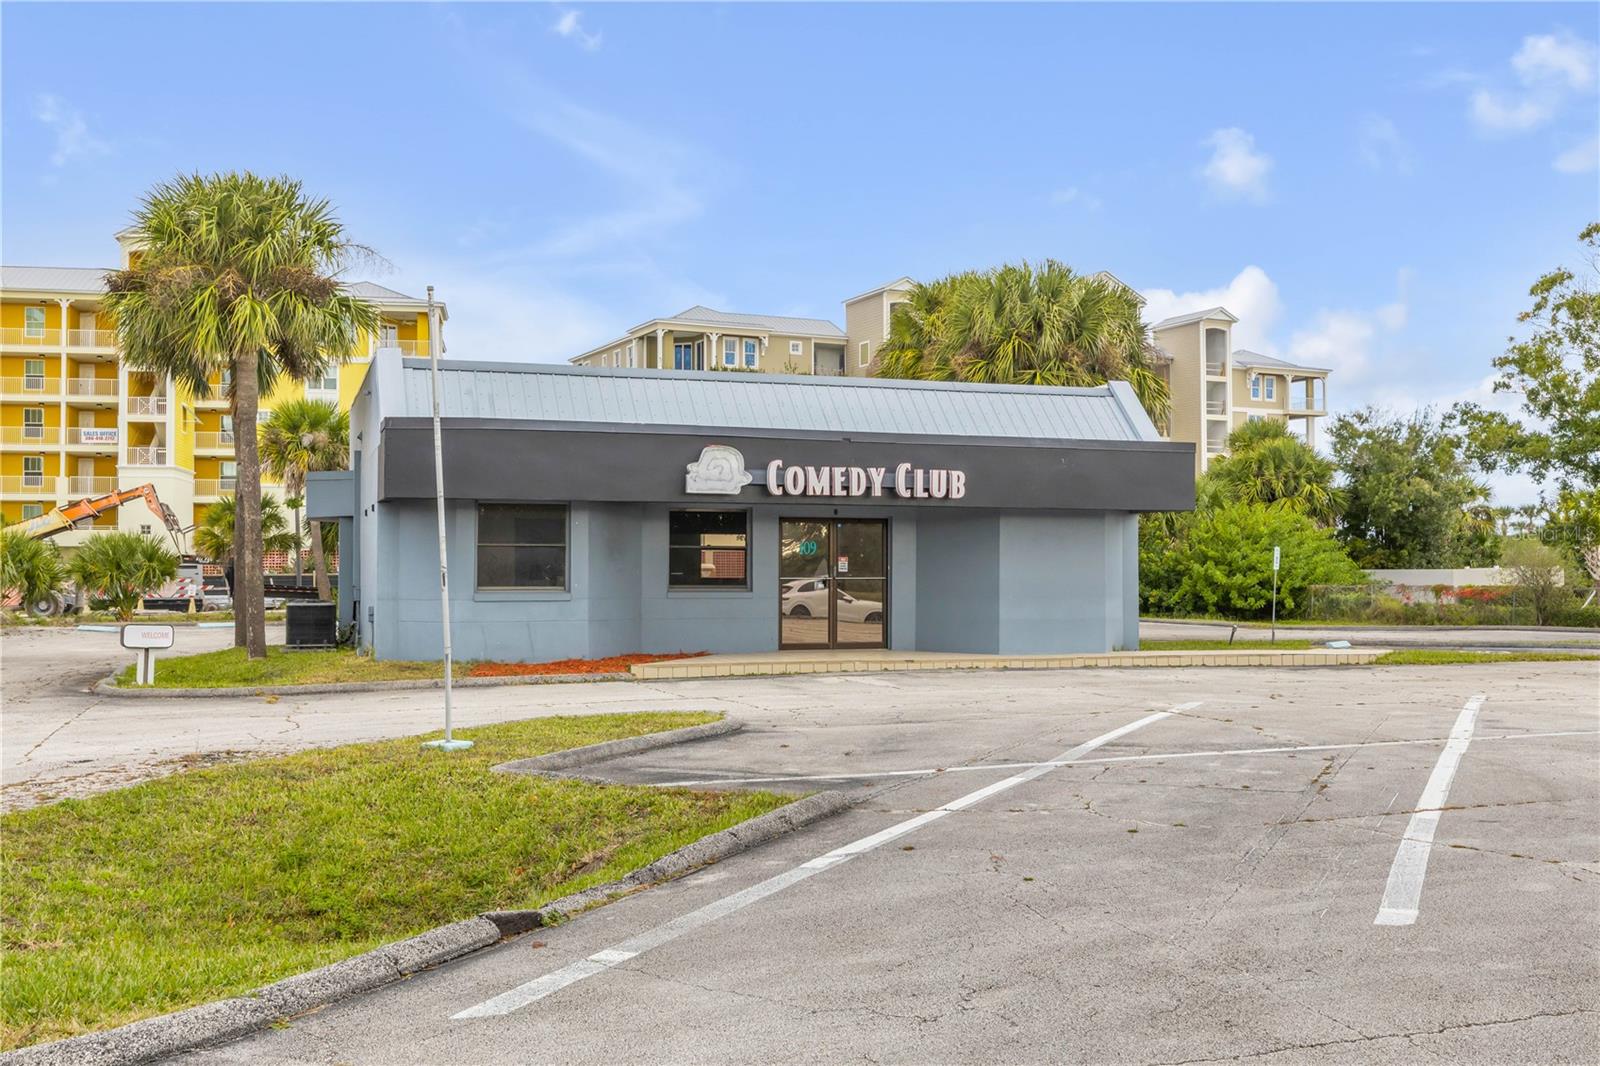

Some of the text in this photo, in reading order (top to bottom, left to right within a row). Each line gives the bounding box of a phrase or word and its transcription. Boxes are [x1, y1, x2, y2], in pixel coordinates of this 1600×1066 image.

[766, 459, 967, 499] COMEDY CLUB
[141, 631, 170, 639] WELCOME
